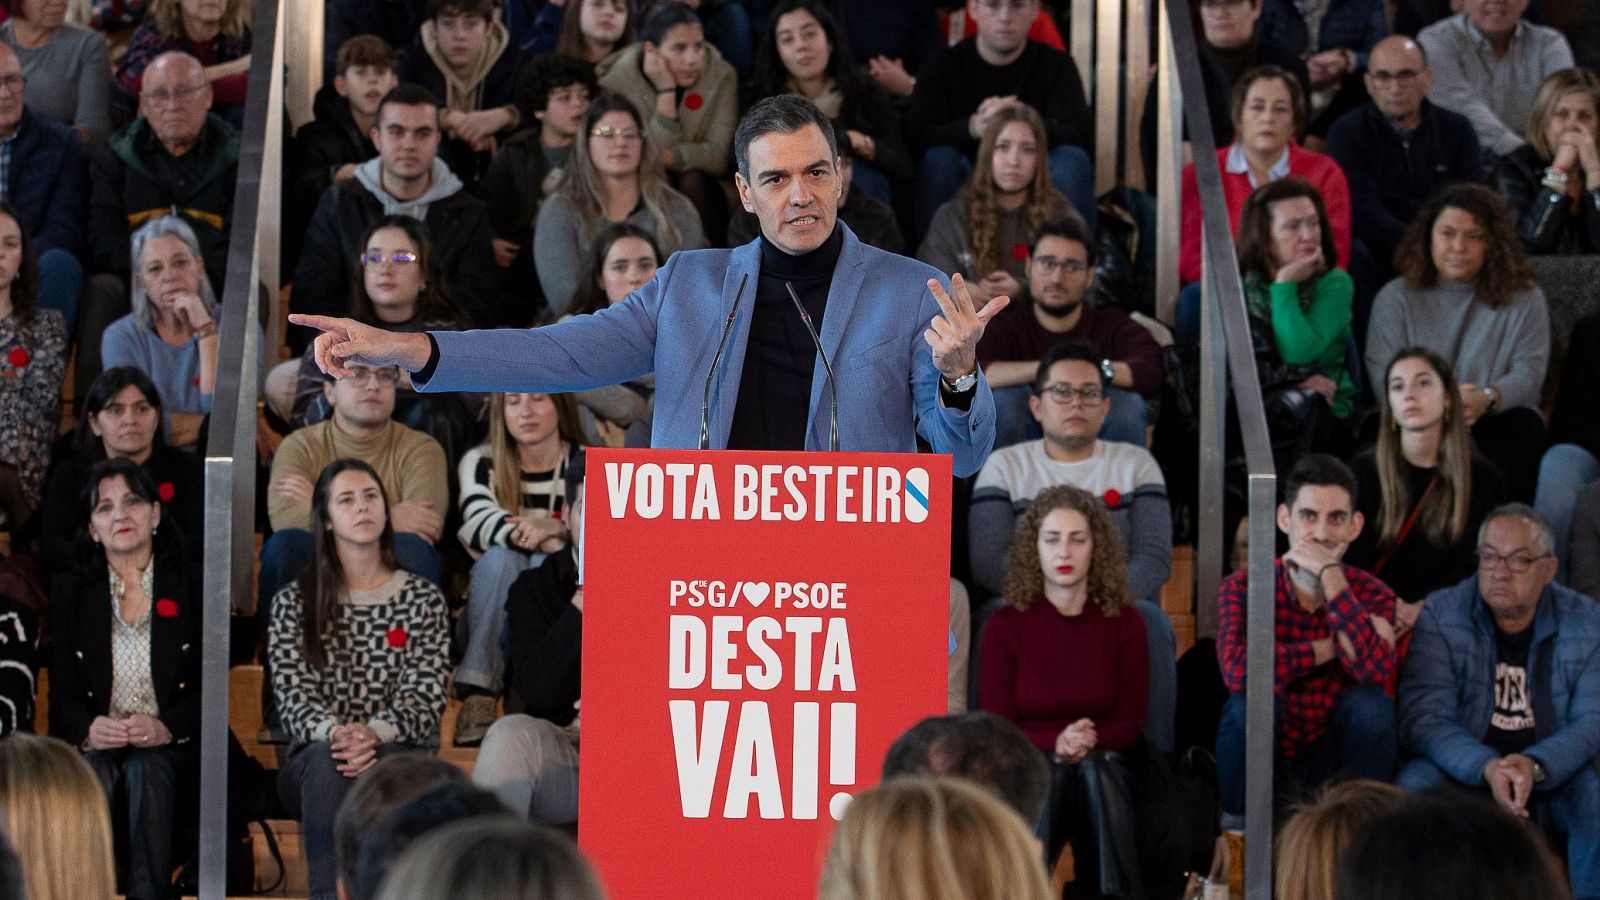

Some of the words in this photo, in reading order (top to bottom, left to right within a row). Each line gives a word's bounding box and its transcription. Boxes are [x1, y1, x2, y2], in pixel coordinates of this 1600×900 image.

[604, 462, 721, 520] VOTA
[733, 464, 930, 524] BESTEIRO
[774, 582, 847, 610] PSOE
[668, 614, 857, 692] DESTA
[668, 699, 857, 821] VAI!
